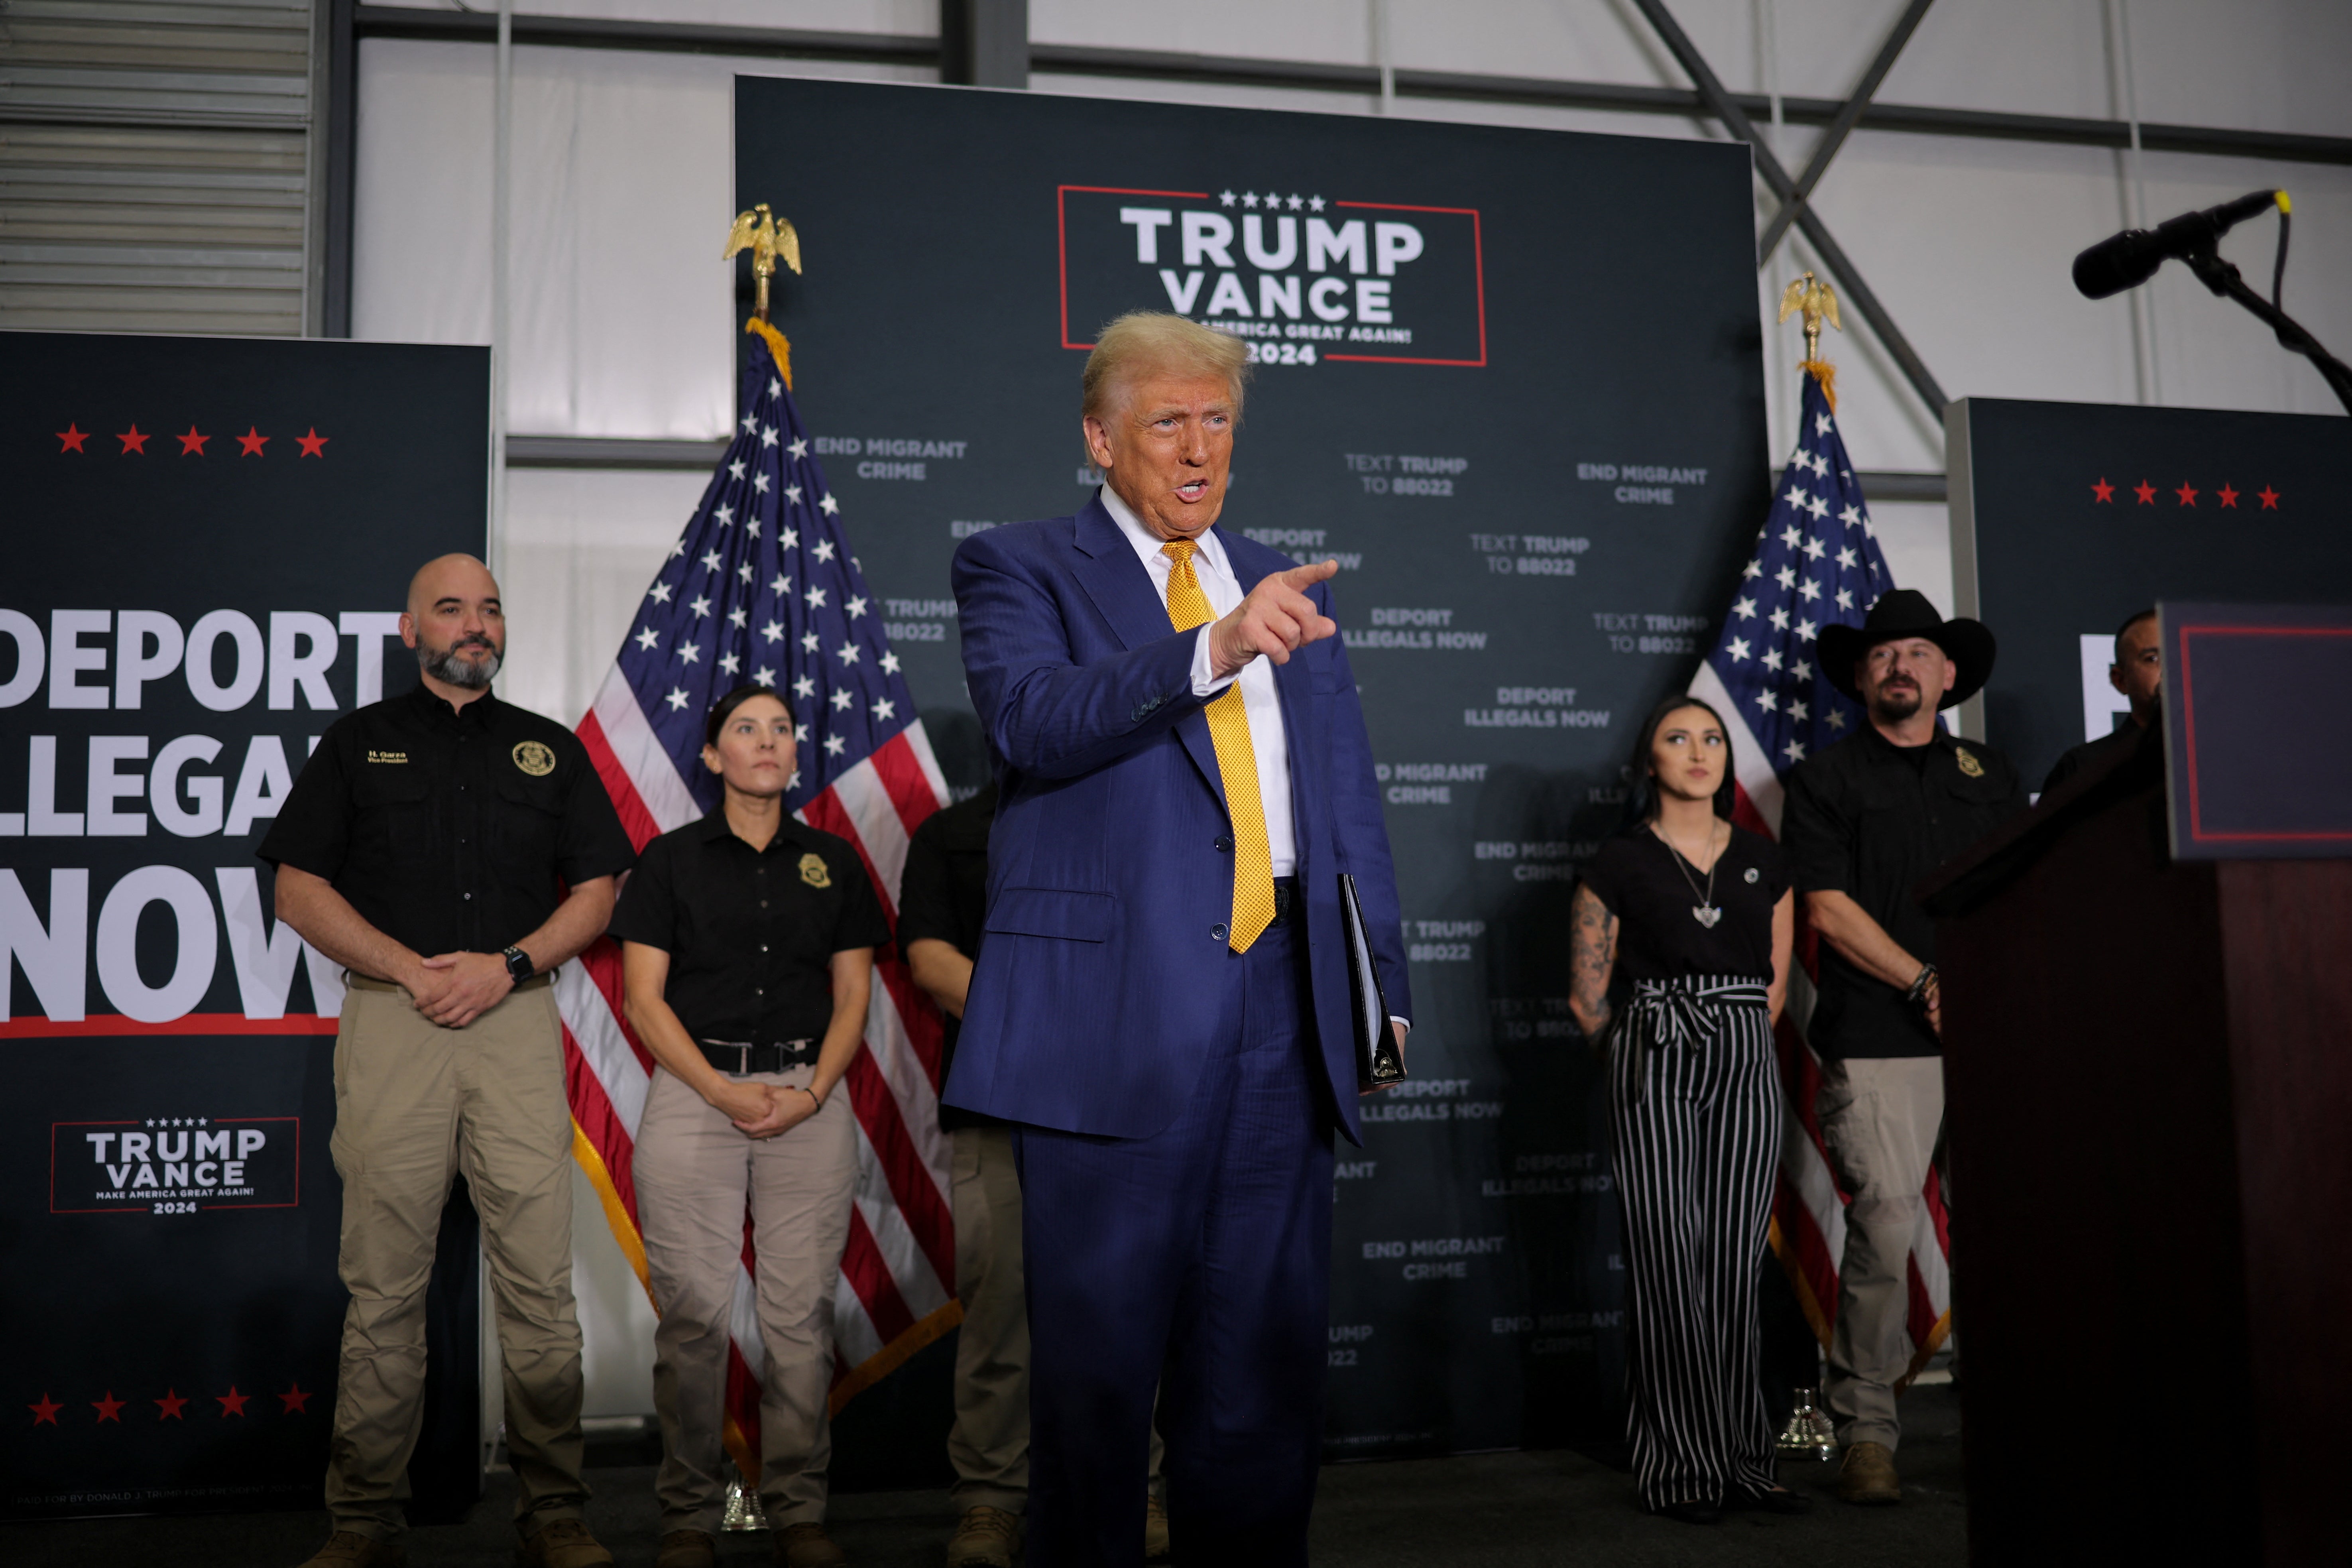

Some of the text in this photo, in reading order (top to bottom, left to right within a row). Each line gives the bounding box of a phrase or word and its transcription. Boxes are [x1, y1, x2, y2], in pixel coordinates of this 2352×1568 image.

[1120, 207, 1424, 275] TRUMP
[1159, 270, 1393, 324] VANCE
[1285, 324, 1345, 341] GREAT
[1349, 327, 1412, 344] AGAIN!
[1247, 342, 1316, 366] 2024
[814, 437, 968, 458] END MIGRANT
[857, 462, 926, 480] CRIME
[1345, 454, 1467, 474] TEXT TRUMP
[1577, 463, 1708, 485] END MIGRANT
[1361, 476, 1453, 496] TO 88022
[1615, 486, 1674, 505] CRIME
[1243, 528, 1327, 547] DEPORT
[1470, 534, 1590, 554] TEXT TRUMP
[1487, 557, 1576, 576] TO 88022
[885, 599, 958, 617] TRUMP
[1372, 608, 1453, 627] DEPORT
[1593, 613, 1709, 633] TEXT TRUMP
[1436, 632, 1487, 650] NOW
[1608, 635, 1634, 653] TO
[1497, 688, 1576, 705] DEPORT
[1465, 710, 1609, 728] ILLEGALS NOW
[1396, 763, 1487, 781] MIGRANT
[1387, 786, 1451, 804] CRIME
[1475, 842, 1598, 859] END MIGRAN
[1416, 920, 1485, 939] TRUMP
[1410, 944, 1471, 961] 88022
[1388, 1080, 1470, 1098] DEPORT
[1455, 1101, 1503, 1118] NOW
[87, 1129, 265, 1163] TRUMP
[106, 1161, 245, 1189] VANCE
[1581, 1174, 1614, 1192] NO
[96, 1187, 254, 1200] MAKE AMERICA GREAT AGAIN!
[153, 1201, 197, 1214] 2024
[1363, 1237, 1505, 1259] END MIGRANT
[1403, 1262, 1467, 1281] CRIME
[1329, 1326, 1373, 1342] UMP
[45, 1495, 66, 1503] FOR
[70, 1494, 83, 1503] BY
[87, 1492, 131, 1502] DONALD
[146, 1489, 182, 1499] TRUMP
[185, 1489, 206, 1497] FOR
